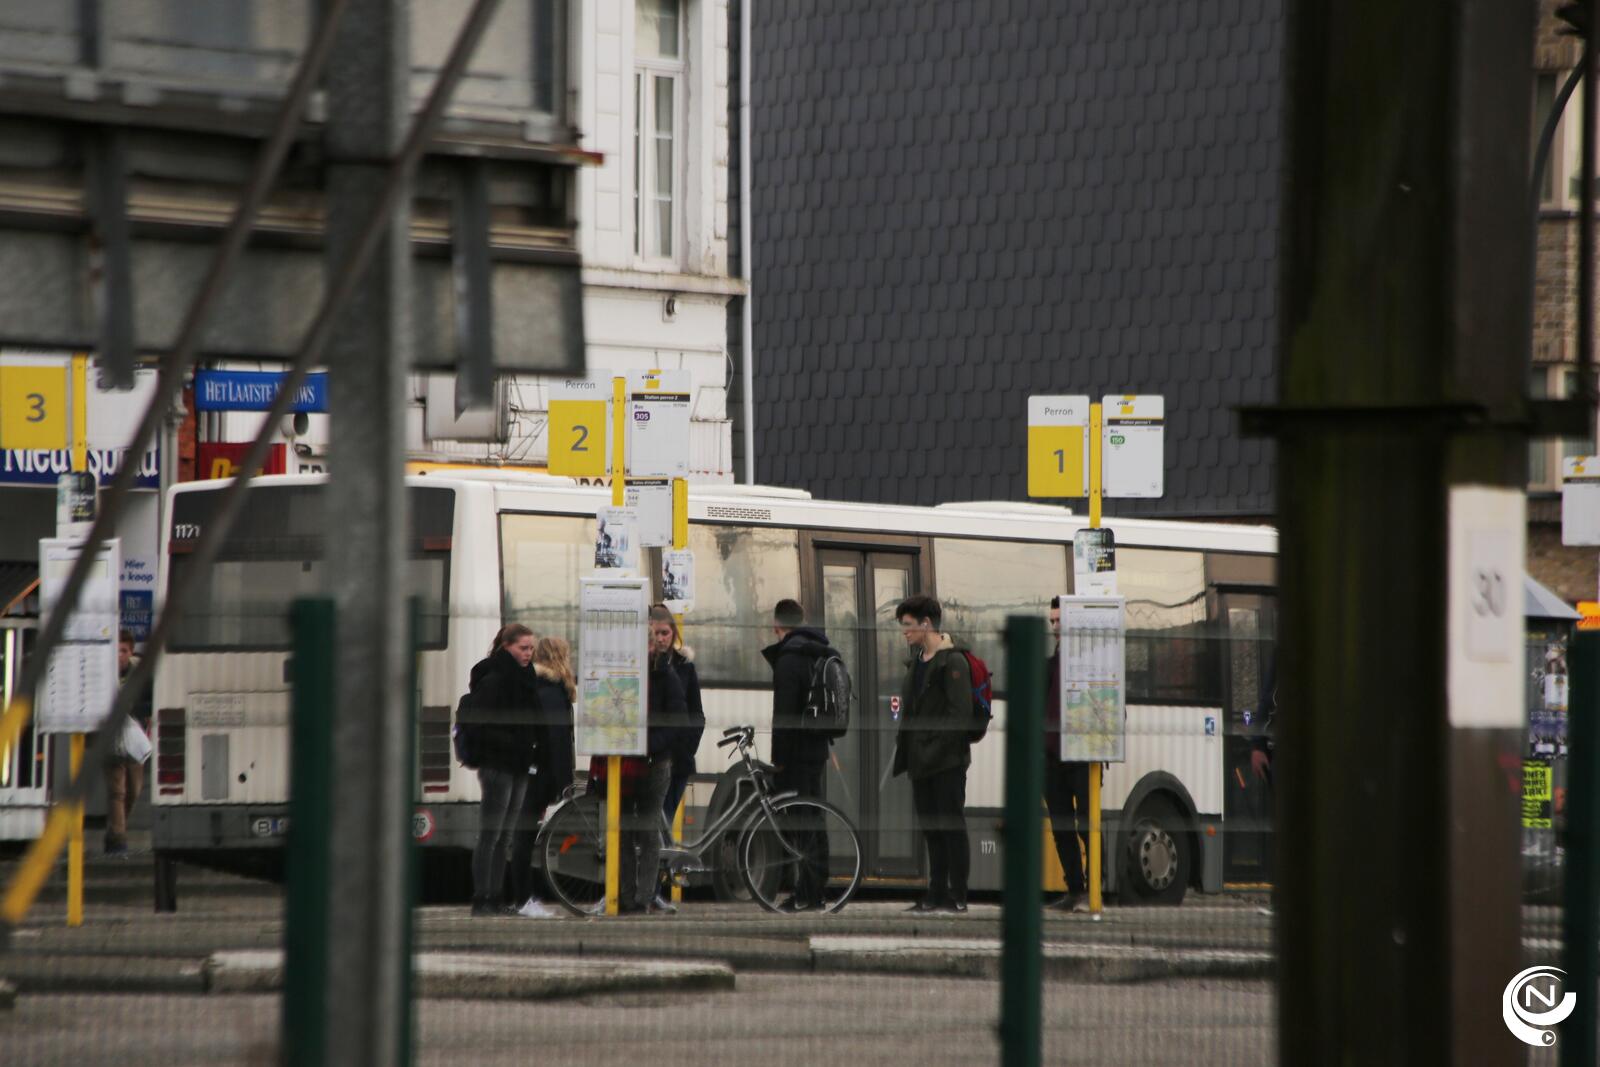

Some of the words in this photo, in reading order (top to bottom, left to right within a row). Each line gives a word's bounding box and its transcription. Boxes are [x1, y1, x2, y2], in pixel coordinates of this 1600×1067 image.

[205, 380, 227, 401] HET
[228, 380, 272, 402] LAATSTE
[565, 380, 596, 390] Perron
[26, 394, 46, 422] 3
[1044, 407, 1073, 416] Perron
[571, 425, 588, 451] 2
[1053, 449, 1064, 473] 1
[175, 524, 200, 538] 1171
[124, 559, 145, 569] Hier
[128, 571, 153, 584] koop
[981, 840, 996, 854] 1171
